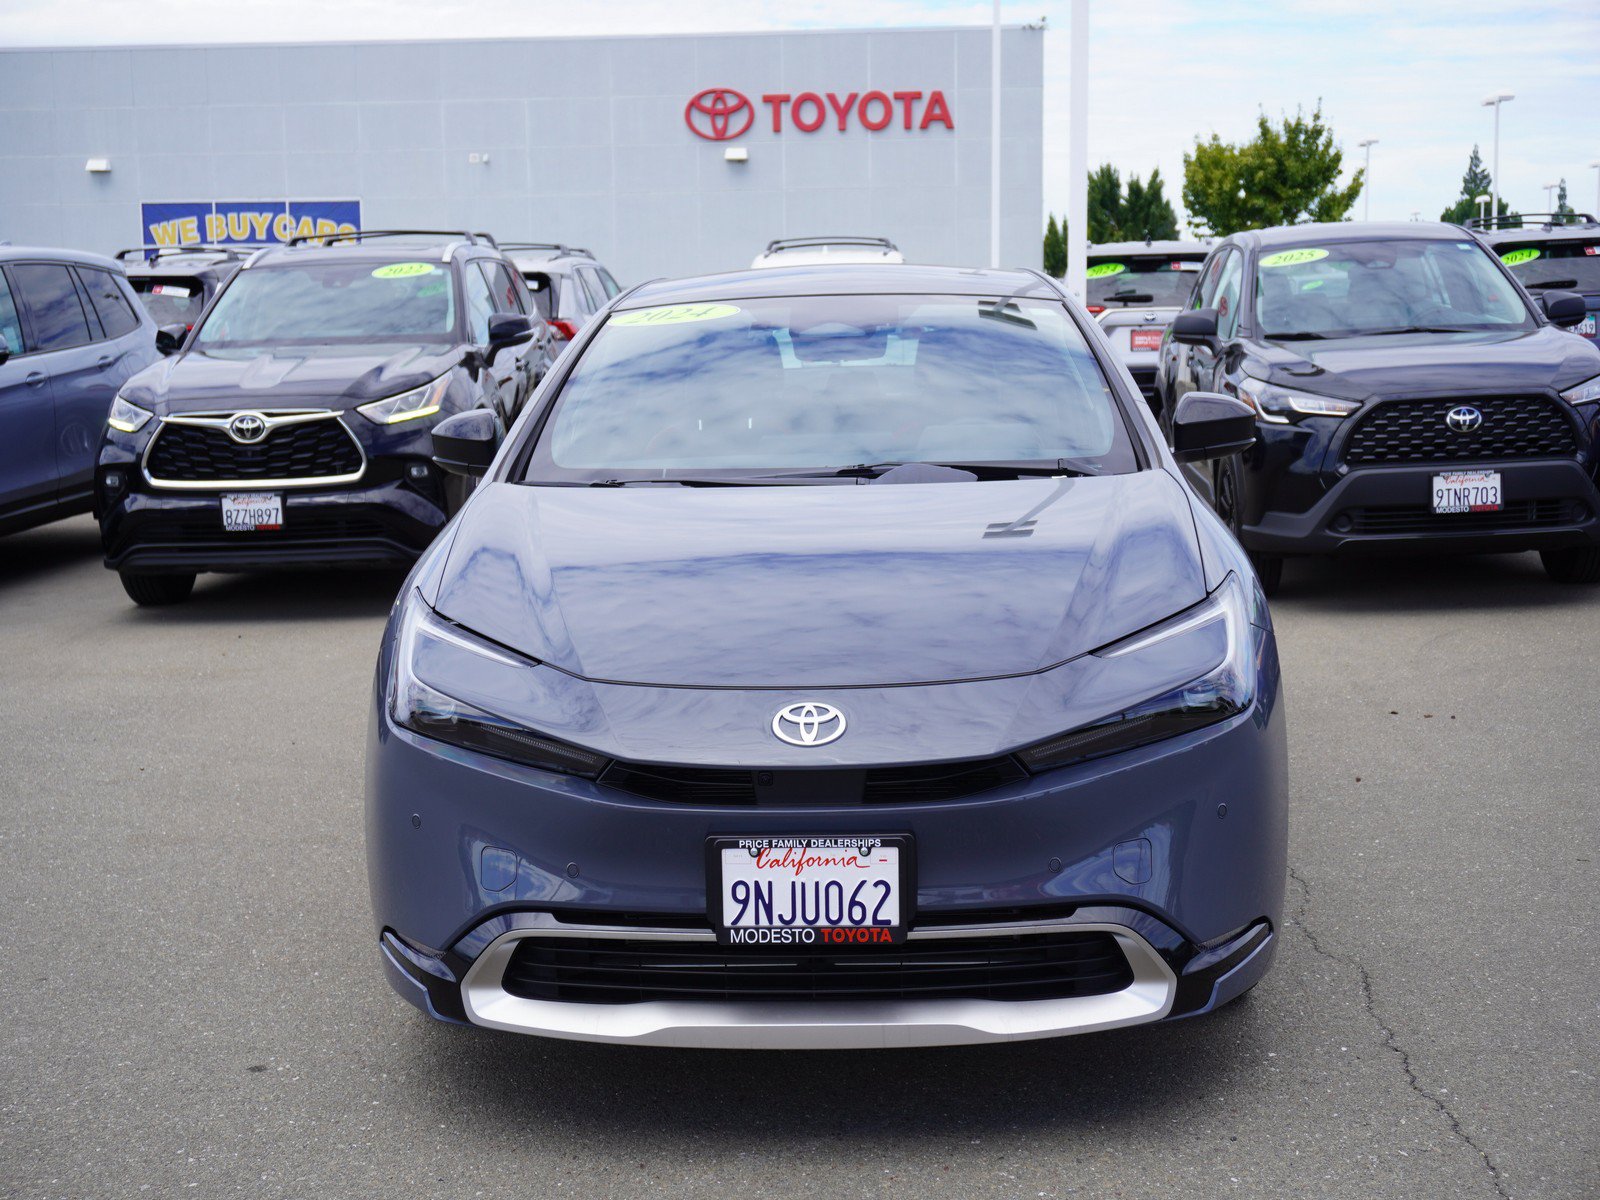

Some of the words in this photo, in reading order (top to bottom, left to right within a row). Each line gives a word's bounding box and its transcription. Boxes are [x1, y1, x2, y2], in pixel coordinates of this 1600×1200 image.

[762, 91, 955, 133] TOYOTA
[149, 216, 200, 247] WE
[205, 211, 273, 242] BUY
[1272, 250, 1317, 265] 2025
[624, 305, 718, 324] 2024
[1436, 486, 1498, 507] 9TNR703
[225, 508, 279, 526] 8ZZH897
[1436, 505, 1470, 513] MODESTO
[739, 840, 769, 848] PRICE
[772, 839, 807, 848] FAMILY
[810, 839, 881, 848] DEALERSHIPS
[756, 847, 870, 876] California
[730, 879, 892, 926] 9NJU062
[730, 928, 815, 943] MODESTO
[821, 928, 892, 943] TOYOTA
